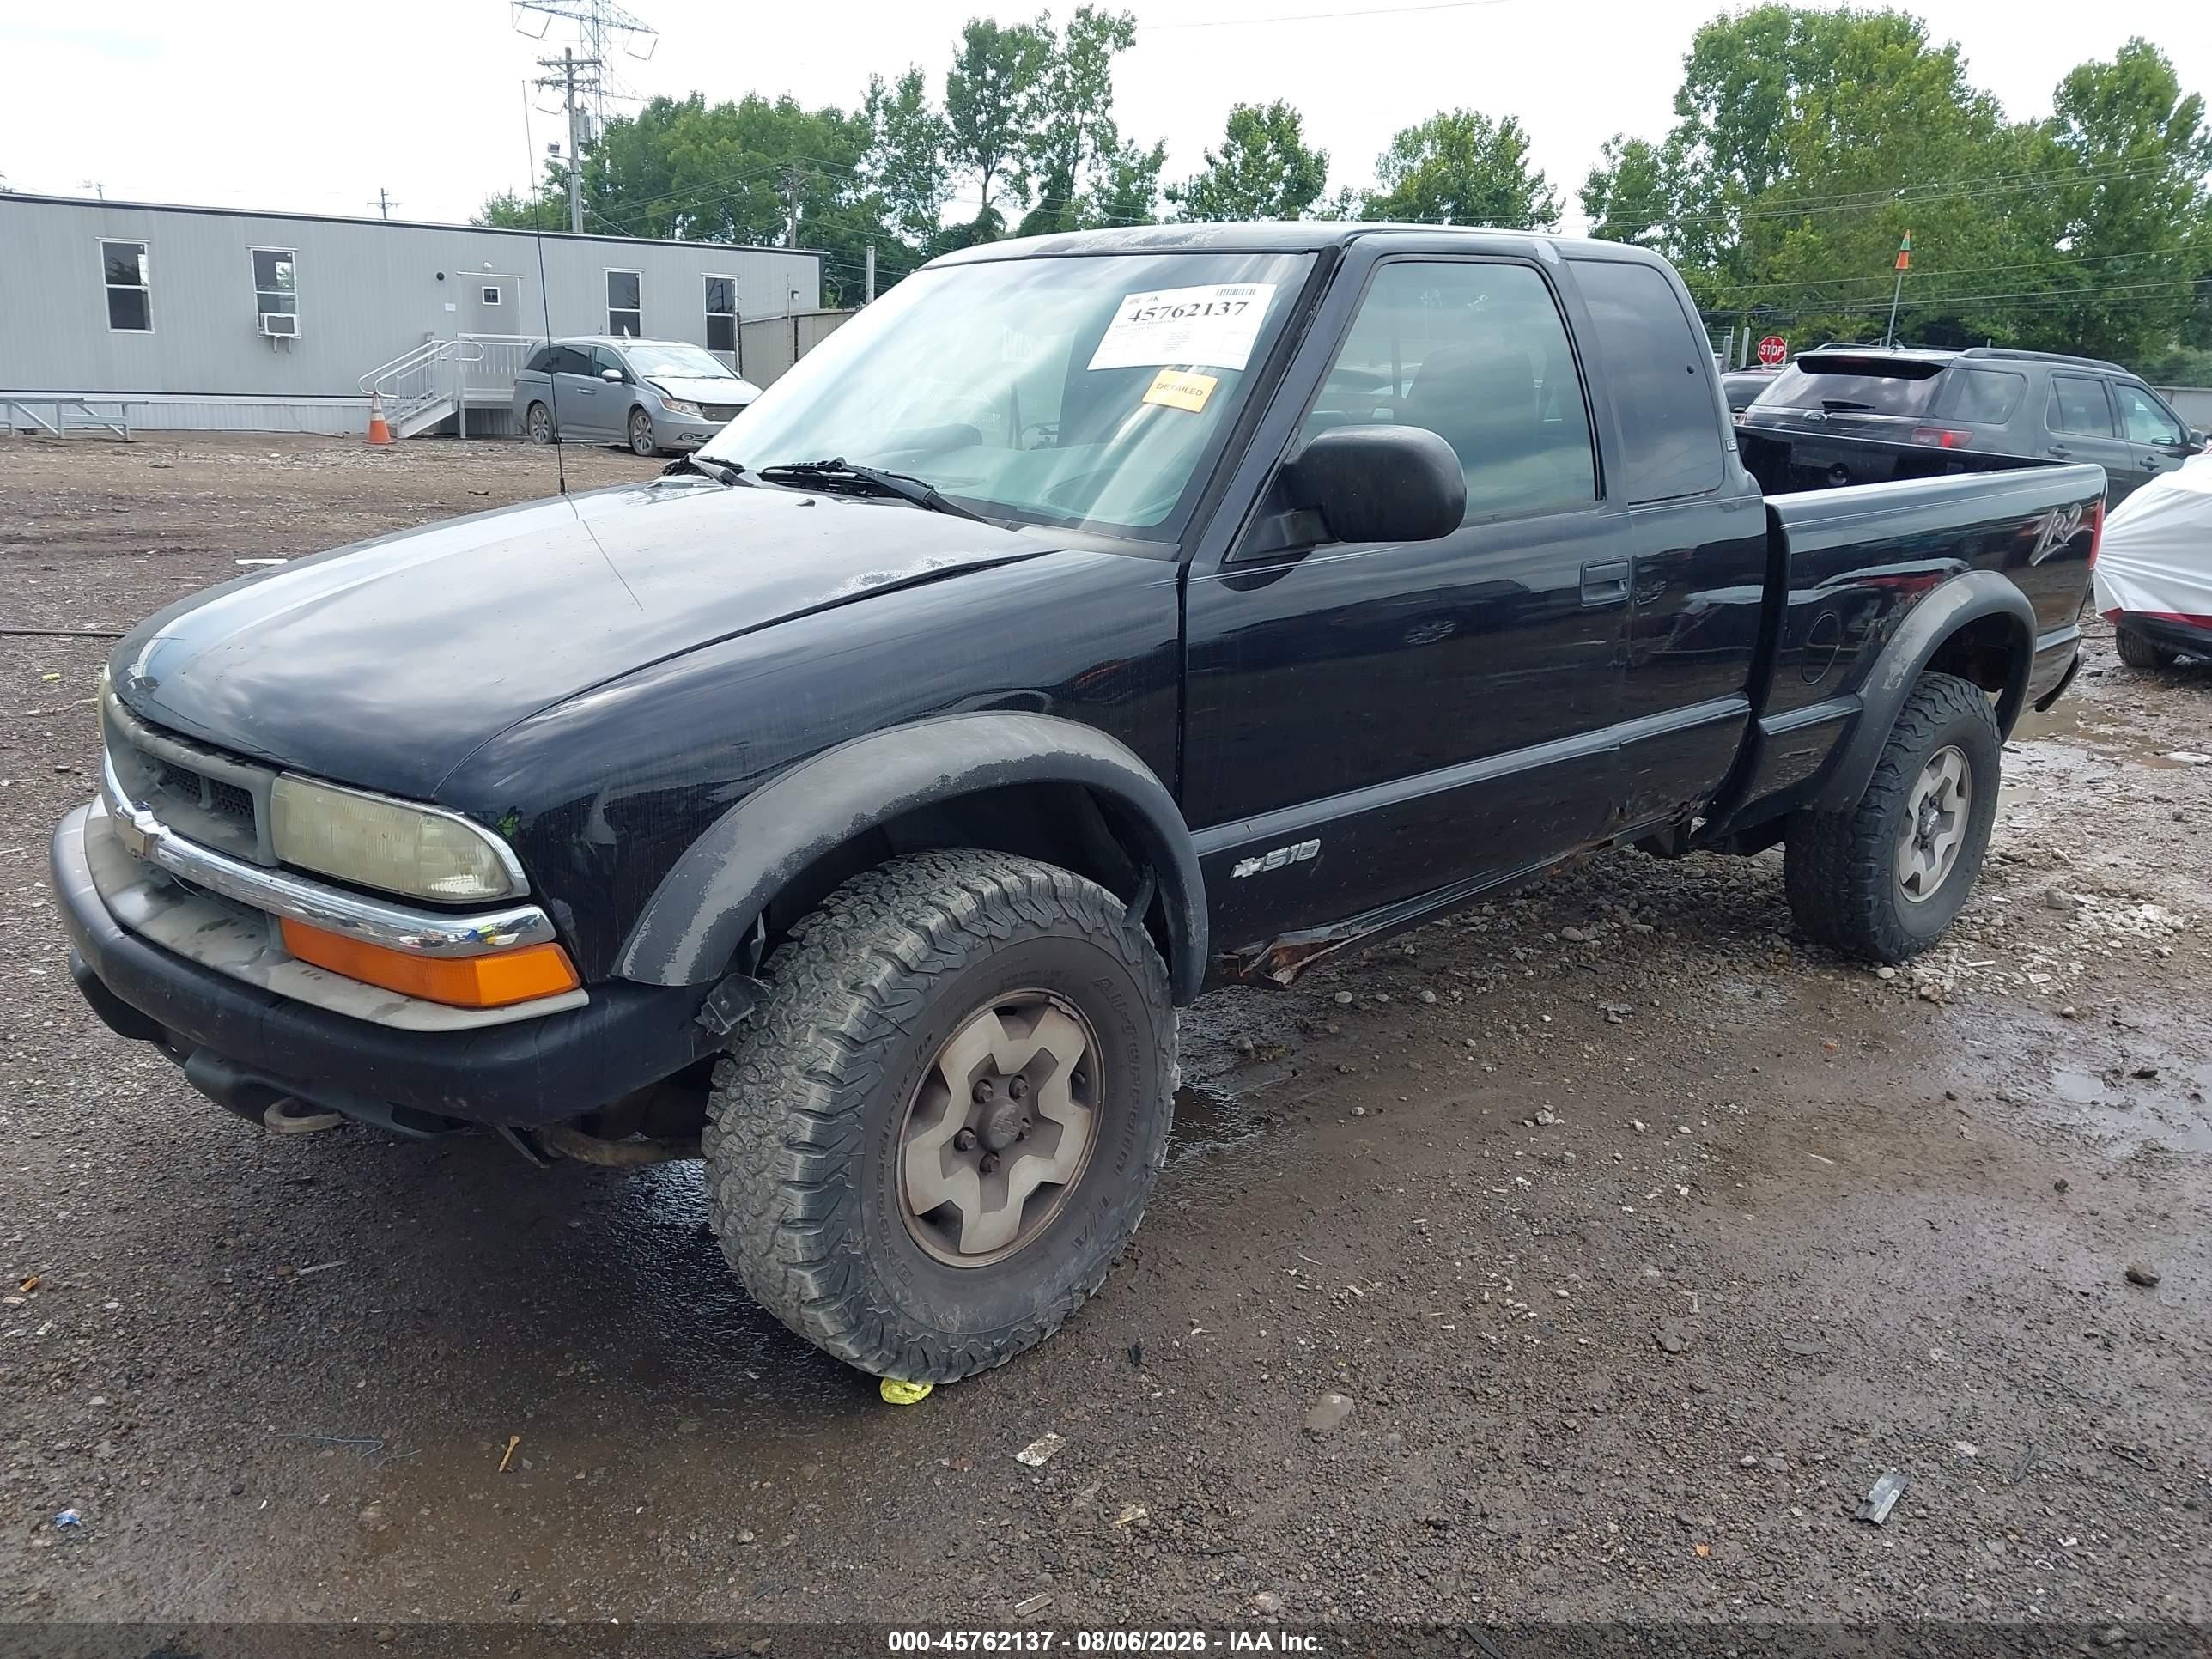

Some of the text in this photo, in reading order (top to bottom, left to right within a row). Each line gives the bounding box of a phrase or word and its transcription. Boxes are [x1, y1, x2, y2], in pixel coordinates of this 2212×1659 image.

[1127, 301, 1249, 322] 45762137
[1760, 344, 1784, 356] STOP
[1156, 383, 1204, 396] DETAILED
